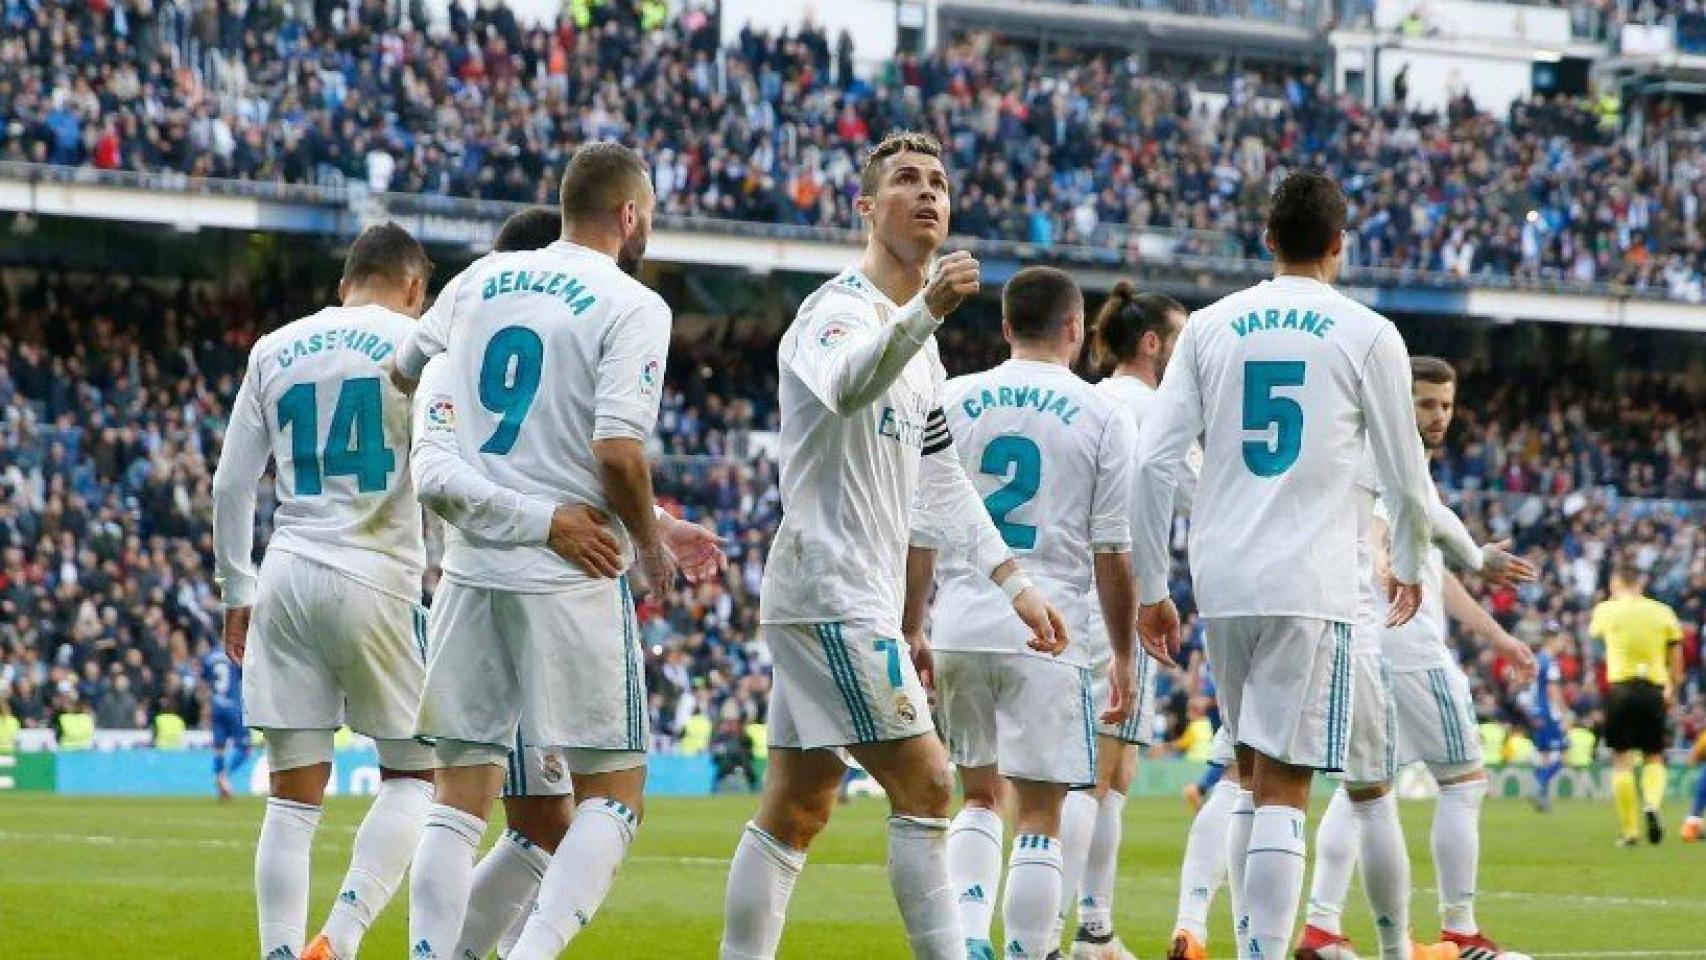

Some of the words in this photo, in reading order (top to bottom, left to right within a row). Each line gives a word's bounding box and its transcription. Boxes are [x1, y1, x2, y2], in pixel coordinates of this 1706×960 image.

[483, 270, 596, 316] BENZEMA
[1231, 308, 1335, 338] VARANE
[279, 329, 394, 368] CASEMIRO
[479, 325, 544, 456] 9
[963, 385, 1081, 425] CARVAJAL
[277, 377, 395, 495] 14
[1242, 360, 1306, 477] 5
[980, 435, 1041, 549] 2
[873, 638, 902, 687] 7
